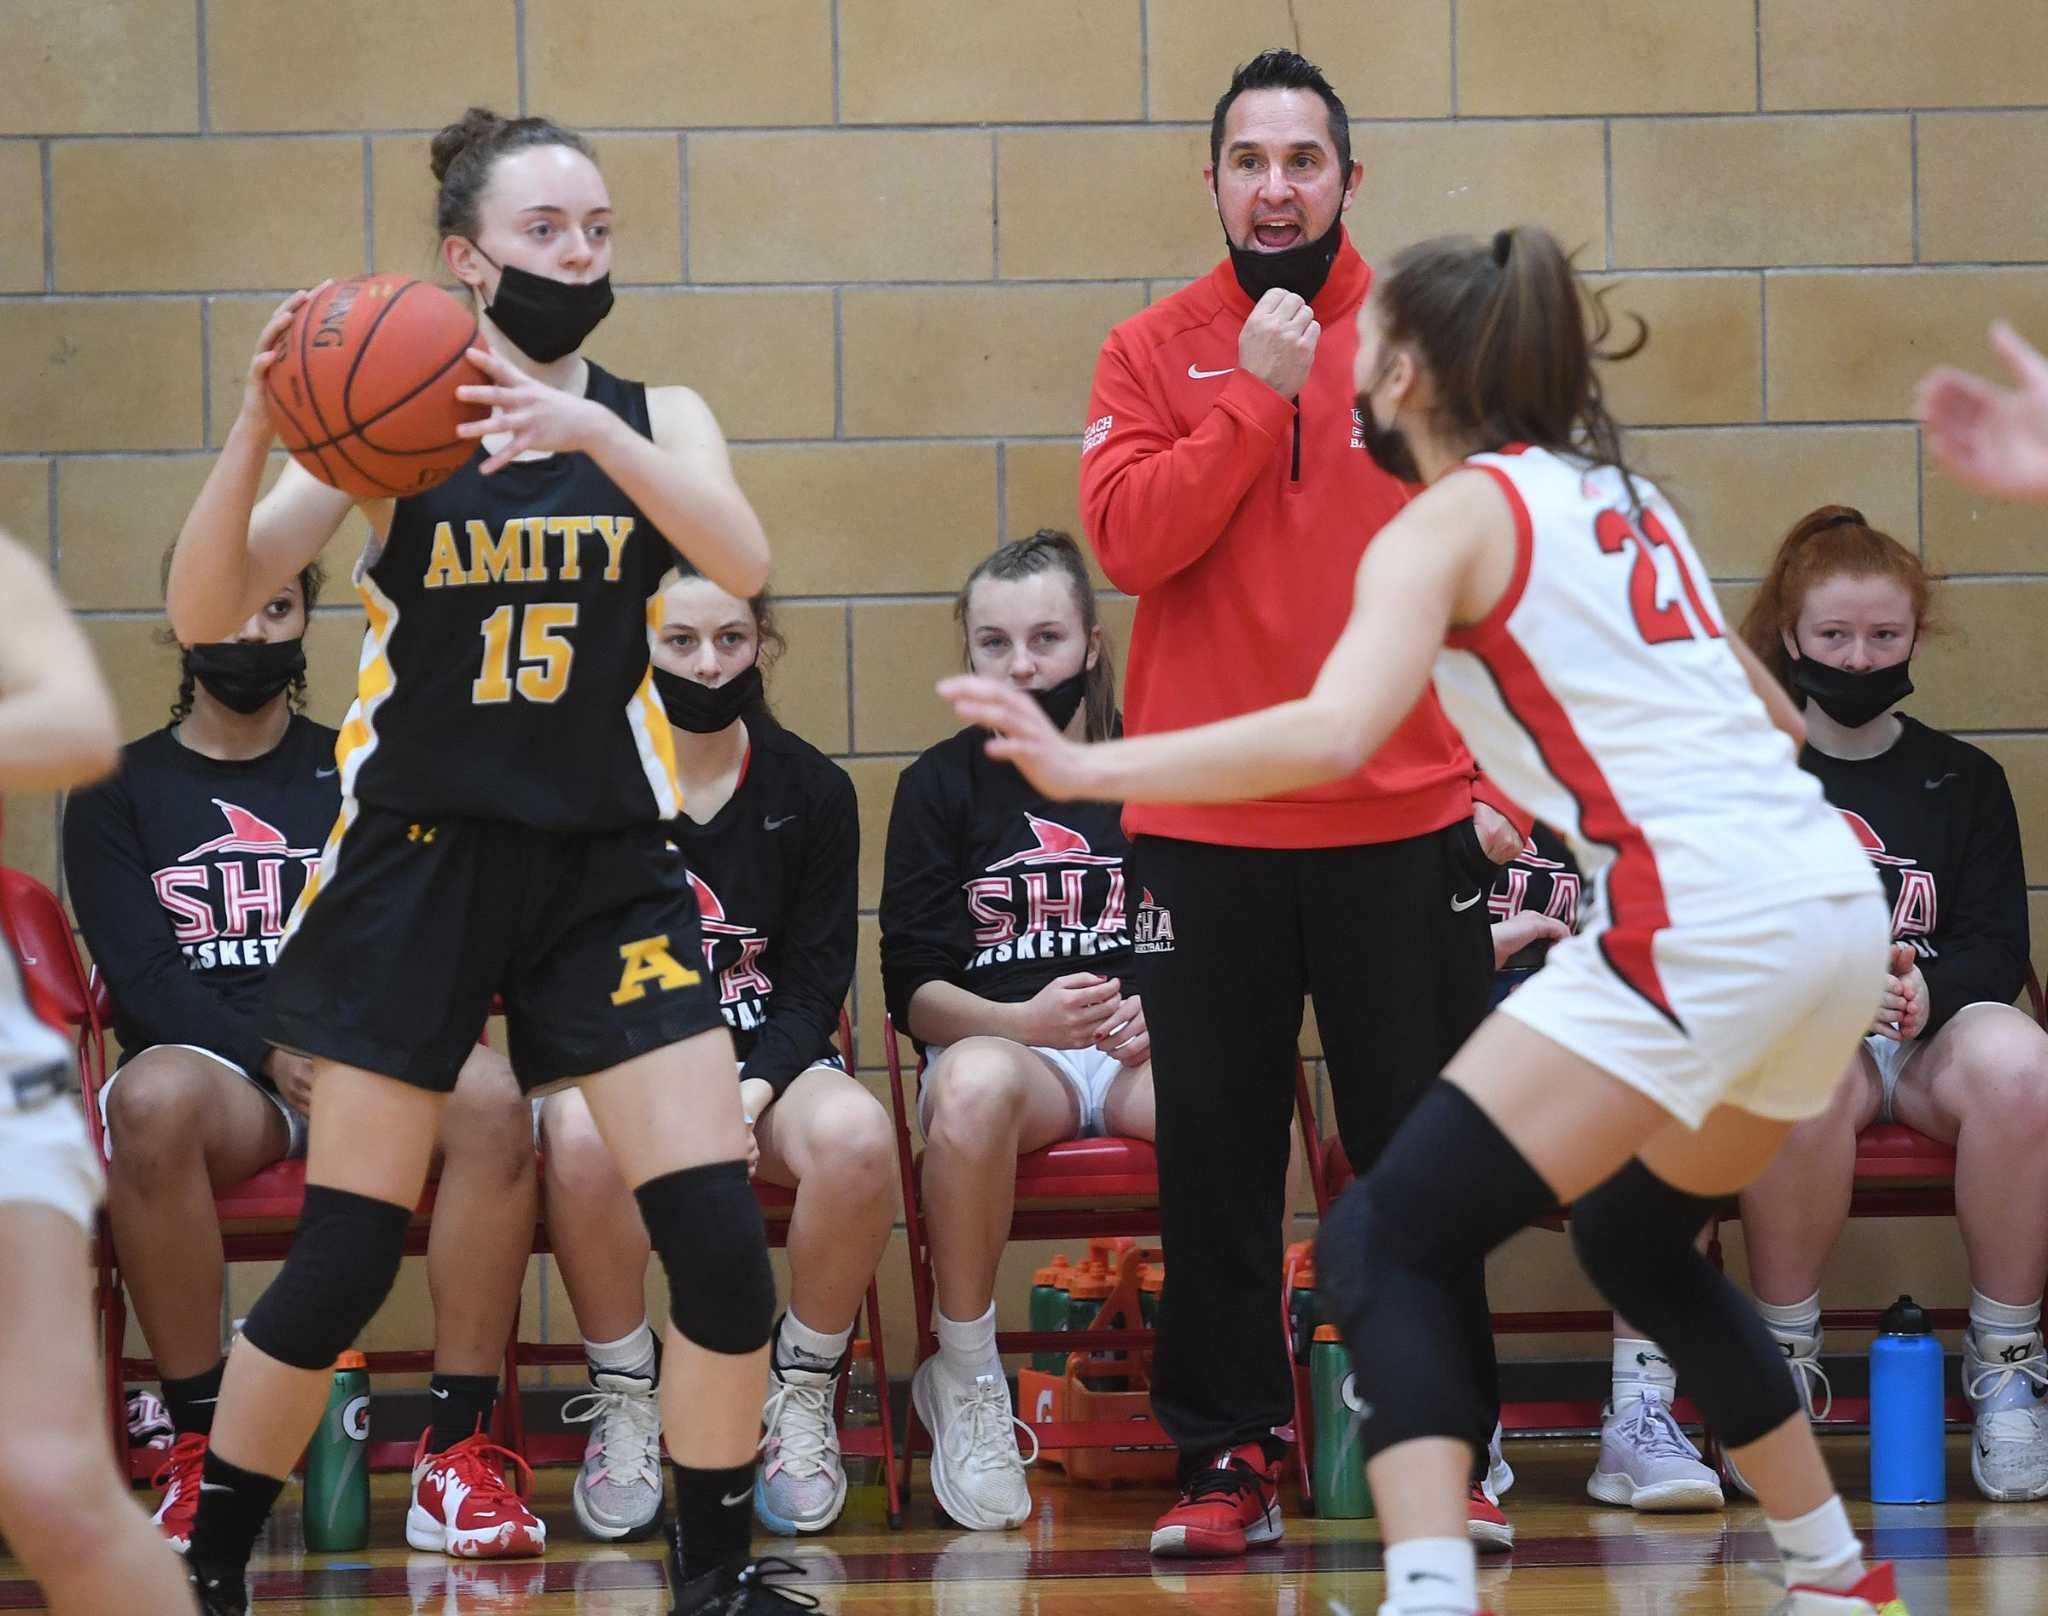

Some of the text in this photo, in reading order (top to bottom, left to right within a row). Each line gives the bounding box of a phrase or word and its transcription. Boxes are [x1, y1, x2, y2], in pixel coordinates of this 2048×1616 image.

[423, 515, 635, 588] AMITY
[472, 602, 579, 704] 15
[610, 933, 702, 1006] A
